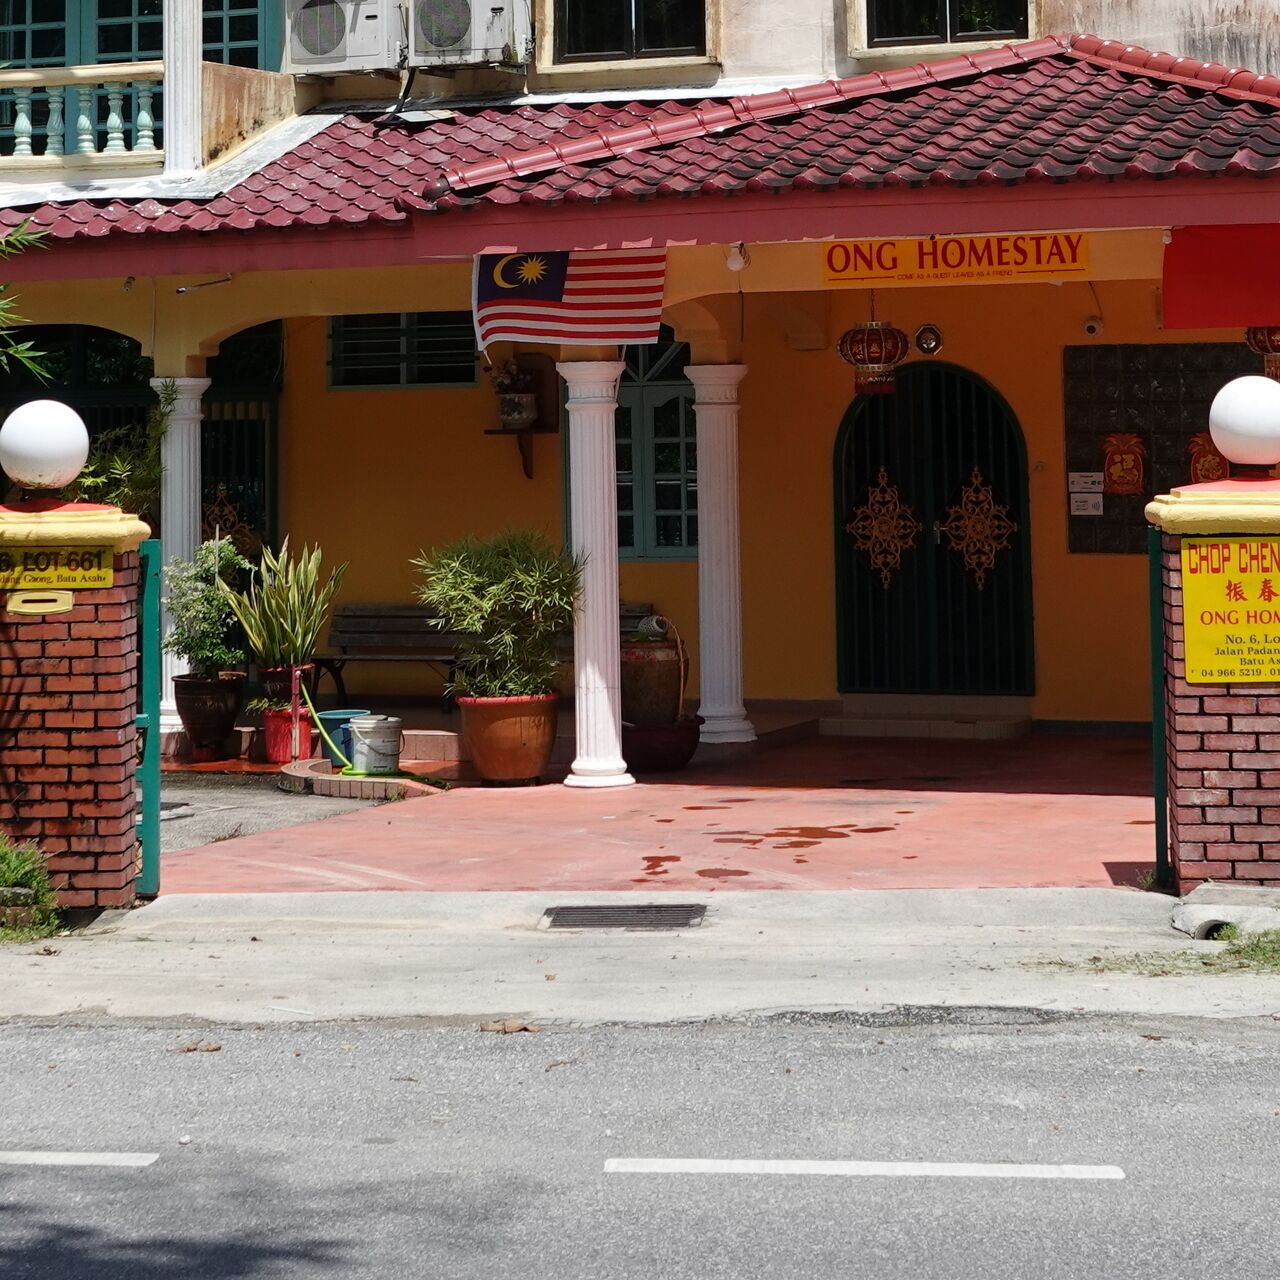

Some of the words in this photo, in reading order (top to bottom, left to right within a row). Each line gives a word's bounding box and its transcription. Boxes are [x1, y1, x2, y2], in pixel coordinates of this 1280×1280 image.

[826, 241, 898, 273] ONG
[917, 234, 1083, 270] HOMESTAY
[23, 551, 63, 572] LOT
[66, 550, 103, 572] 661
[1188, 543, 1231, 574] CHOP
[56, 574, 77, 583] Batu
[1200, 610, 1239, 625] ONG
[1225, 634, 1246, 644] No.
[1249, 634, 1261, 645] 6,
[1214, 647, 1243, 656] Jalan
[1239, 657, 1265, 665] Batu
[1201, 669, 1214, 677] 04
[1217, 668, 1236, 677] 966
[1239, 668, 1262, 677] 5219
